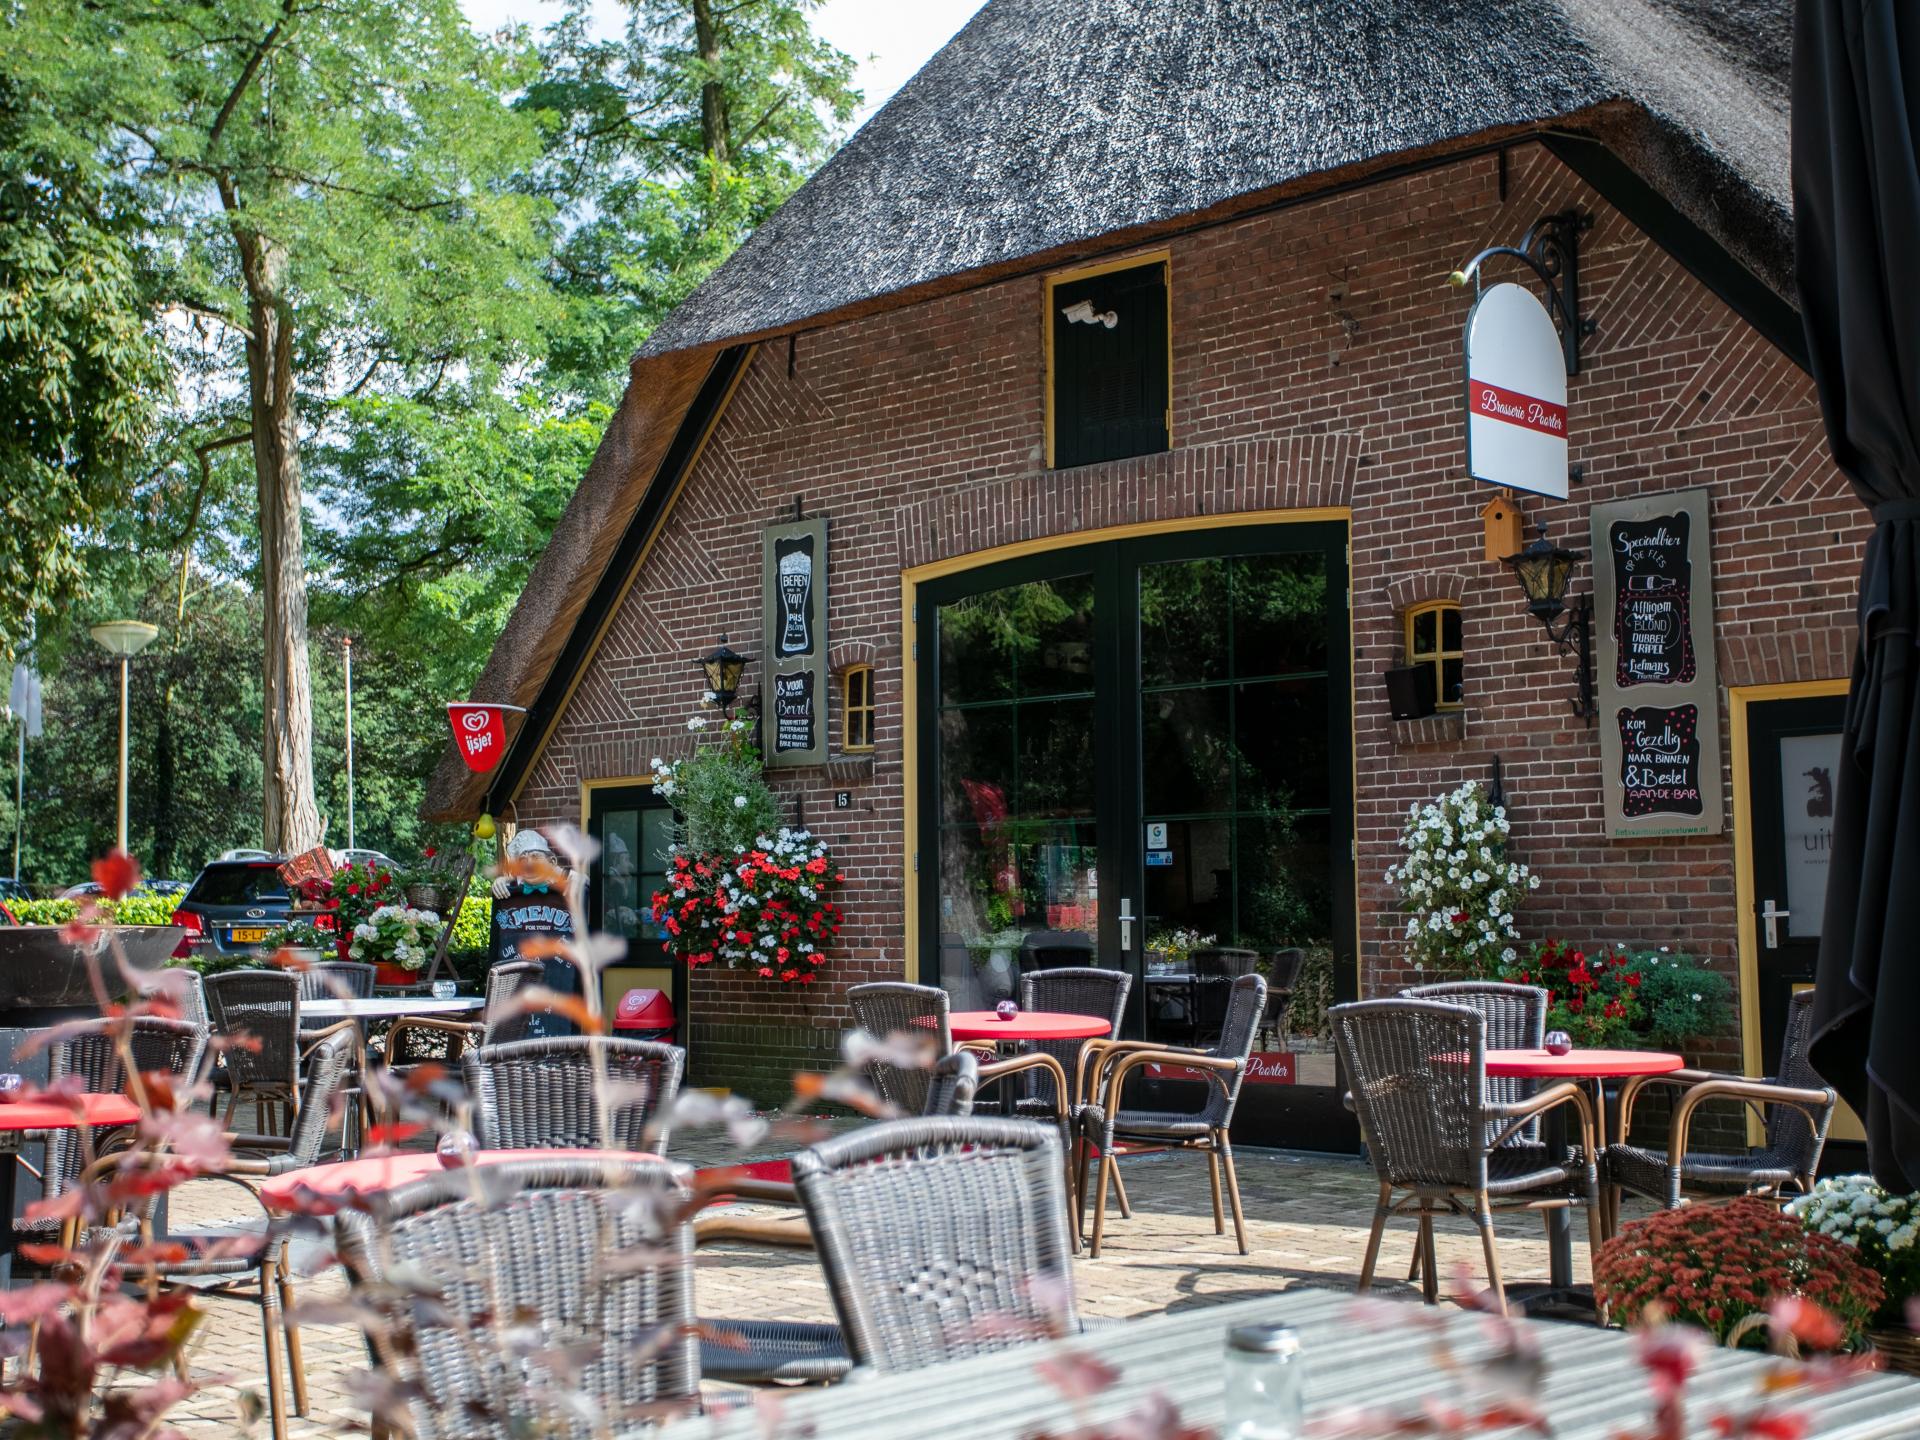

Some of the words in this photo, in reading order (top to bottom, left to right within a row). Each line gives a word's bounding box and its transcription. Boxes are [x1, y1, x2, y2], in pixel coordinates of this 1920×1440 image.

[1481, 389, 1525, 420] Brasserie
[1527, 403, 1562, 431] Poorter
[1615, 527, 1680, 557] Speciaalbier
[1632, 550, 1644, 561] DE
[1648, 549, 1666, 568] FLES
[1631, 601, 1671, 616] Affligem
[1634, 620, 1667, 631] BLOND
[1632, 633, 1666, 644] DUBBEL
[1629, 659, 1670, 676] Liefmans
[1627, 720, 1646, 730] KOM
[465, 732, 492, 756] ijsje?
[1636, 725, 1680, 755] Gezellig
[1628, 754, 1653, 763] NAAR
[1641, 768, 1687, 788] Bestel
[838, 793, 848, 807] 15
[512, 906, 569, 926] MENU
[1244, 1057, 1288, 1077] Poorter
